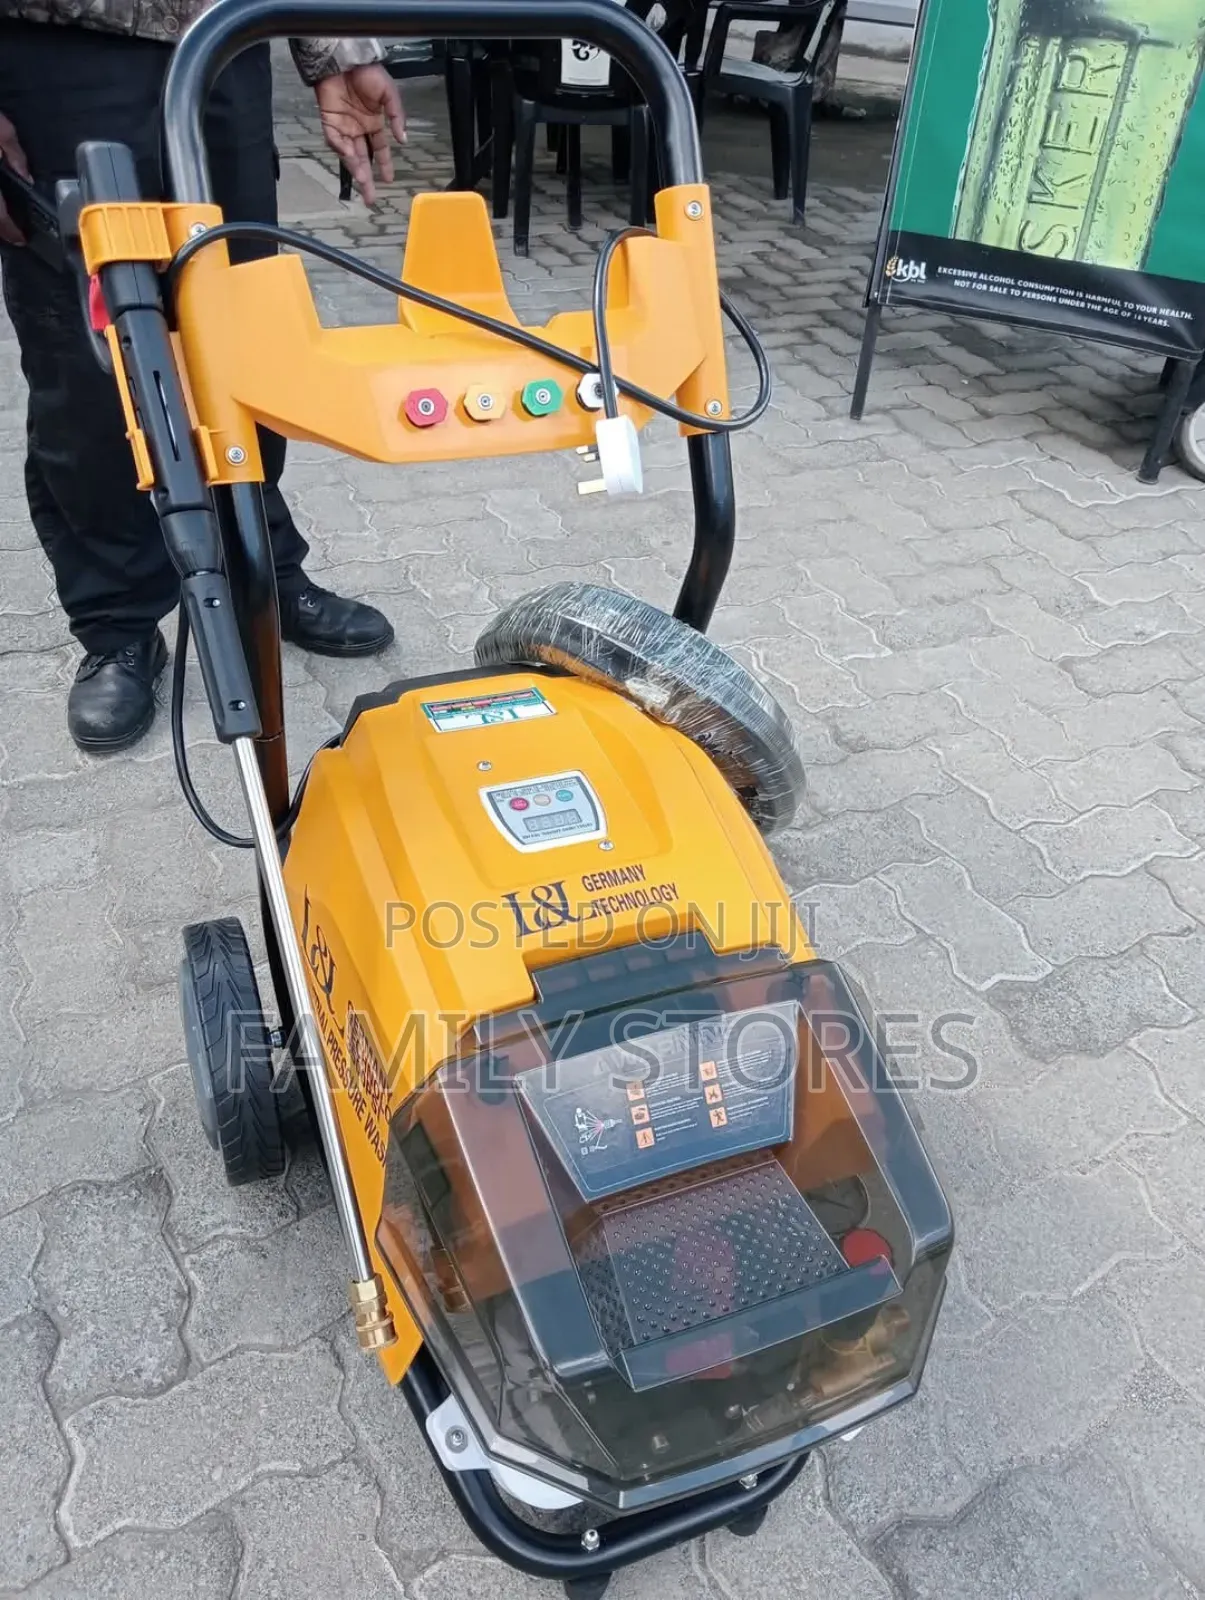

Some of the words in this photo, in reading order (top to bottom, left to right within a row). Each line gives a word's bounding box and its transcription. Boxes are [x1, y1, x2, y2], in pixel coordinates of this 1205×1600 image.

[896, 258, 927, 281] kbl
[937, 266, 978, 279] EXCESSIVE
[978, 273, 1016, 286] ALCOHOL
[1017, 279, 1074, 297] CONSUMPTION
[1076, 289, 1084, 299] IS
[1085, 291, 1122, 308] HARMFUL
[1124, 301, 1135, 310] TO
[1136, 304, 1158, 315] YOUR
[954, 279, 970, 289] NOT
[972, 282, 987, 292] FOR
[988, 285, 1007, 295] SALE
[1010, 288, 1021, 297] TO
[1022, 290, 1057, 304] PERSONS
[1058, 297, 1086, 309] UNDER
[1086, 302, 1102, 312] THE
[1103, 306, 1119, 316] AGE
[1121, 310, 1131, 319] OF
[581, 864, 647, 893] GERMANY
[591, 882, 680, 917] TECHNOLOGY
